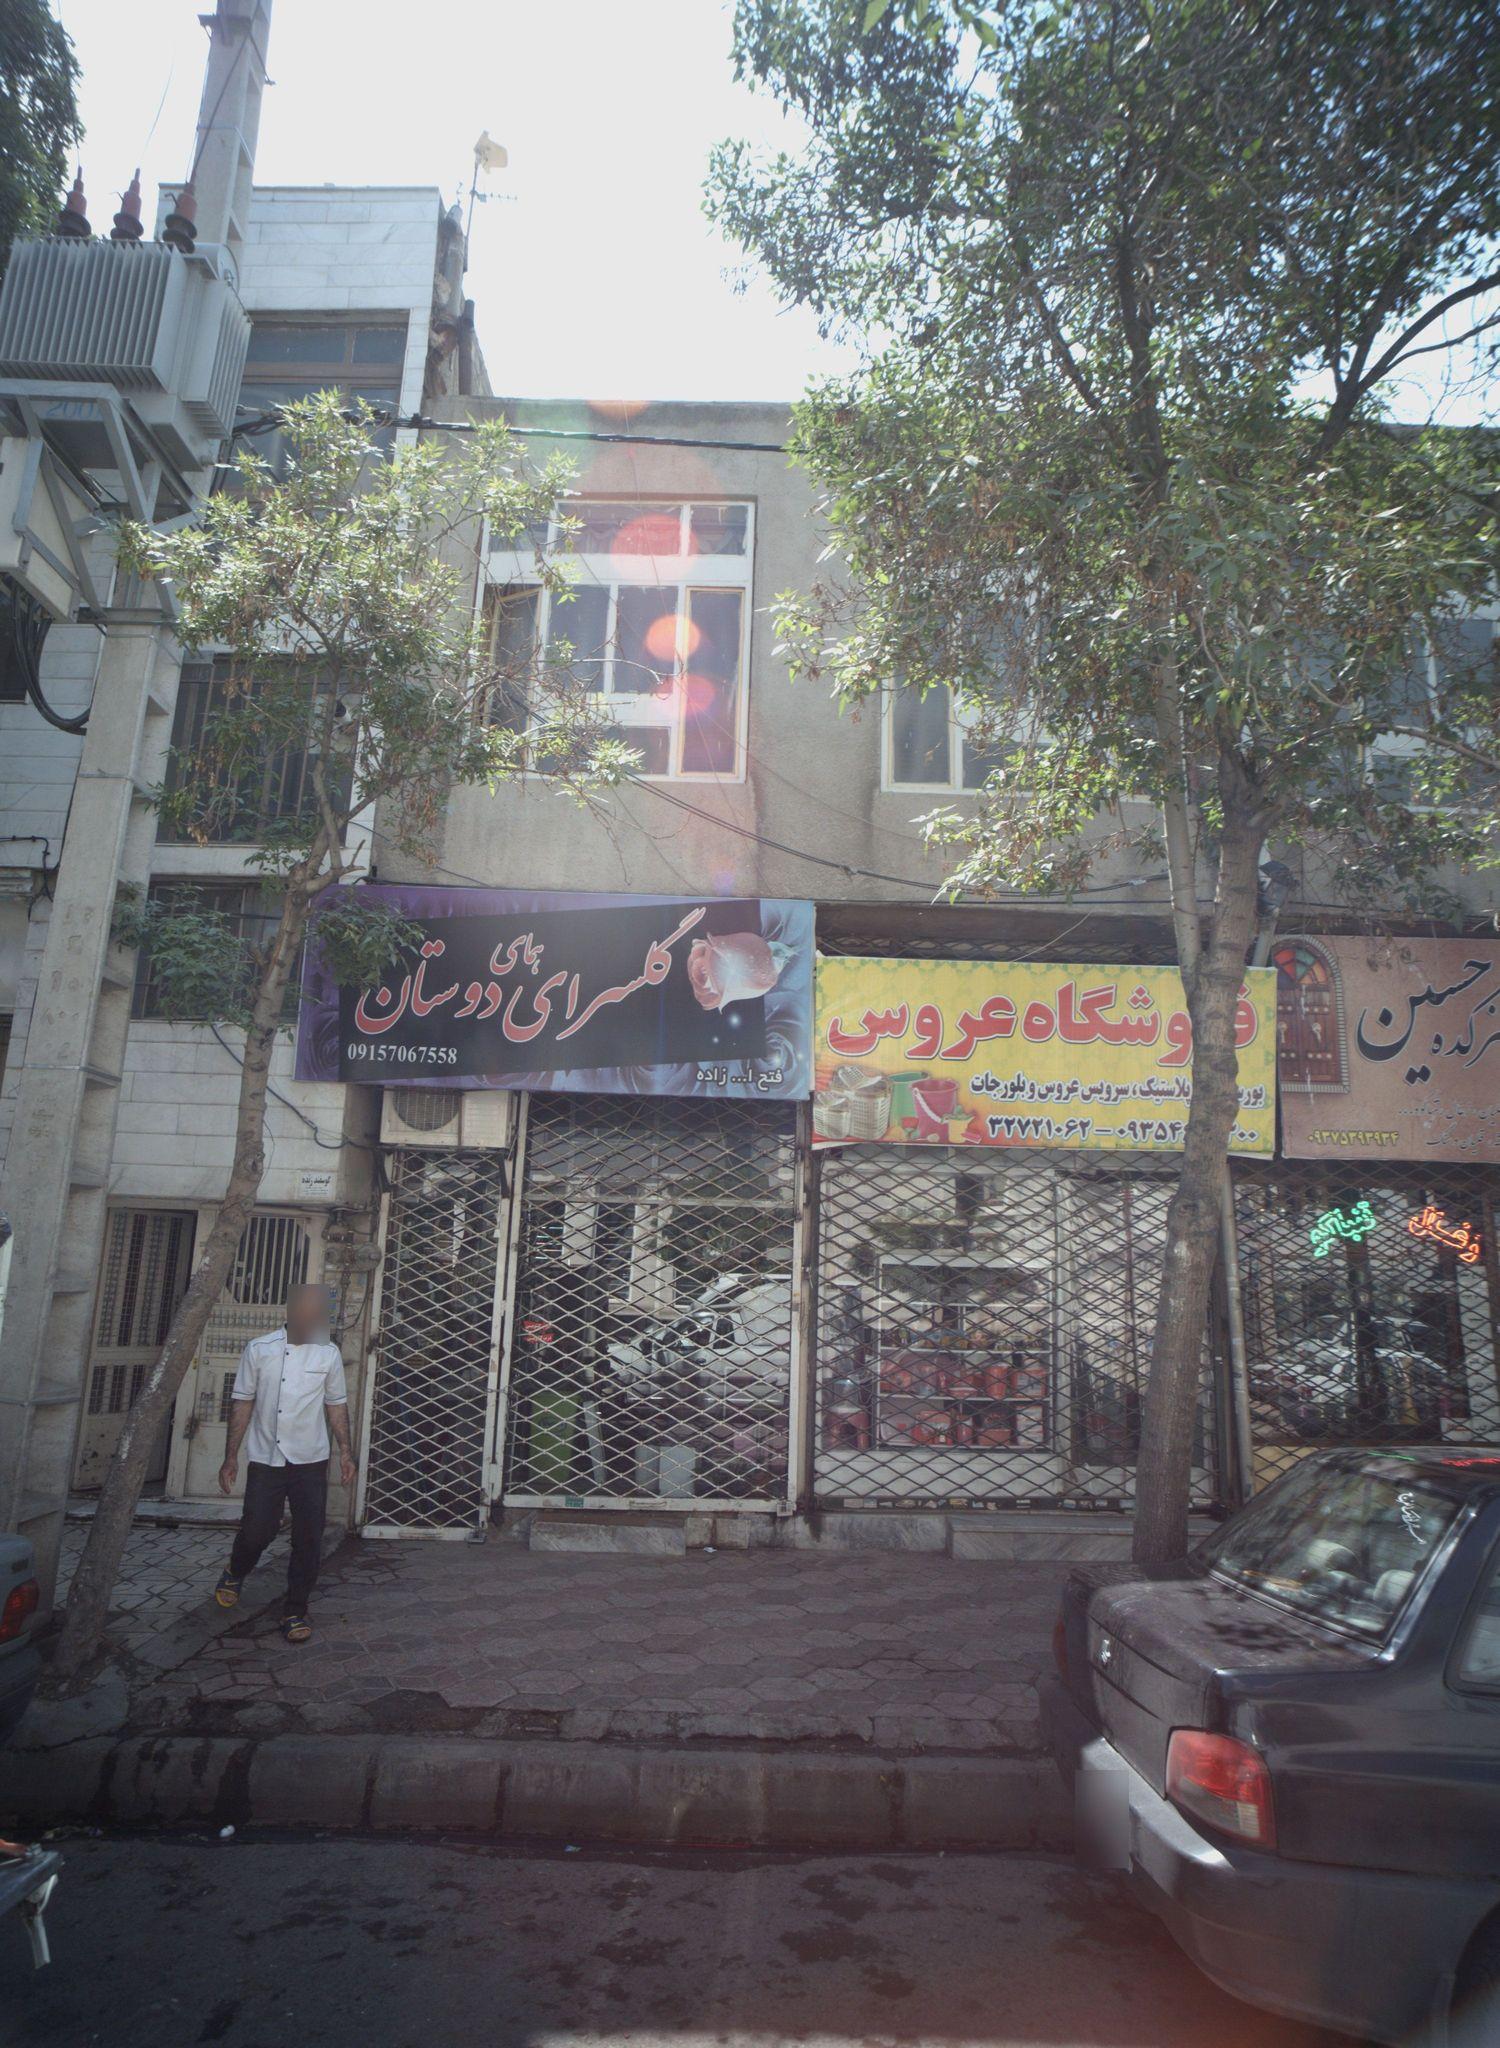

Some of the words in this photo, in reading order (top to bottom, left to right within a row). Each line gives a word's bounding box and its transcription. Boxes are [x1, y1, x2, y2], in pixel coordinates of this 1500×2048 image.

[502, 905, 706, 1043] گلسرای
[354, 939, 502, 1036] دوستان
[827, 993, 1017, 1061] عروس
[1356, 959, 1493, 1085] حسین
[347, 1043, 458, 1064] 09157067558
[696, 1067, 726, 1086] زاده
[757, 1068, 783, 1091] فتح
[1038, 1078, 1080, 1101] عروس
[1081, 1079, 1129, 1102] سرویس
[987, 1115, 1091, 1139] ۳۲۷۲۱۰۶۲
